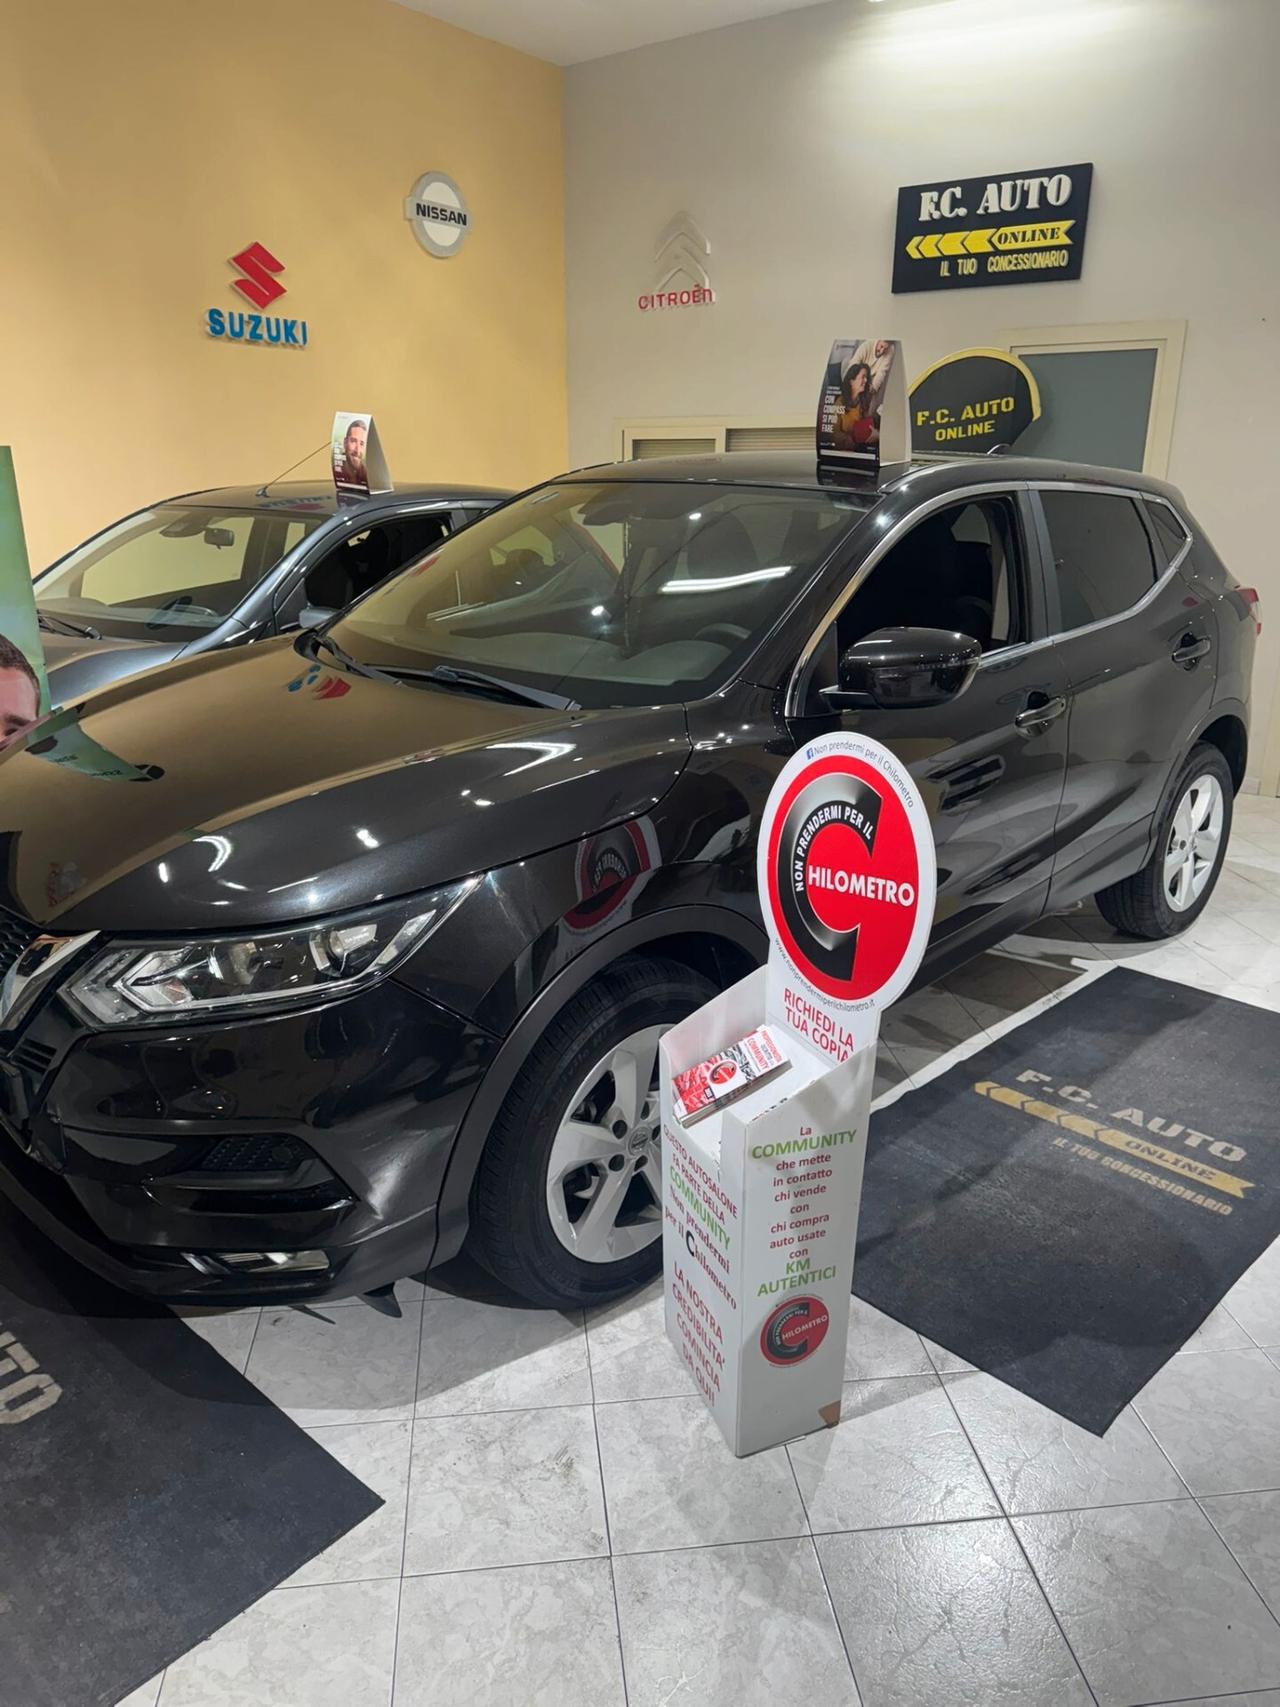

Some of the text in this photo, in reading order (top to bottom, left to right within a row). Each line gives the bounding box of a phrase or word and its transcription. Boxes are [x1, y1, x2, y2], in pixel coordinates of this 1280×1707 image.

[416, 203, 467, 226] NISSAN
[918, 174, 1072, 221] F.C. AUTO
[997, 227, 1060, 245] ONLINE
[940, 250, 1069, 277] IL TUO CONCESSIONARIO
[208, 308, 308, 346] SUZUKI
[916, 397, 1015, 426] F.C. AUTO
[935, 420, 996, 441] ONLINE
[814, 740, 914, 808] Non prendermi per il Chilometro
[794, 805, 874, 892] NON PRENDERMI PER IL
[784, 987, 854, 1052] RICHIEDI LA
[786, 1006, 809, 1037] TUA
[812, 1027, 849, 1063] COPIA
[752, 1129, 857, 1159] COMMUNITY
[800, 1126, 812, 1136] La
[1109, 1107, 1247, 1162] AUTO
[664, 1124, 737, 1219] QUESTO AUTOSALONE
[773, 1168, 832, 1187] in contatto
[776, 1153, 831, 1171] che mette
[1124, 1139, 1217, 1181] ONLINE
[673, 1153, 725, 1225] FA PARTE DELLA
[774, 1184, 827, 1202] chi vende
[1070, 1142, 1100, 1161] TUO
[1100, 1156, 1234, 1216] CONCESSIONARIO
[670, 1165, 730, 1250] COMMUNITY
[771, 1213, 830, 1234] chi compra
[790, 1203, 809, 1214] con
[670, 1184, 730, 1274] Non prendermi
[769, 1228, 826, 1249] auto usate
[665, 1205, 737, 1310] per il Chilometro
[785, 1258, 811, 1275] KM
[789, 1248, 808, 1259] con
[757, 1265, 837, 1297] AUTENTICI
[674, 1261, 723, 1345] LA NOSTRA
[672, 1283, 725, 1371] CREDIBILITA'
[677, 1312, 720, 1392] COMINCIA
[682, 1342, 694, 1372] DA
